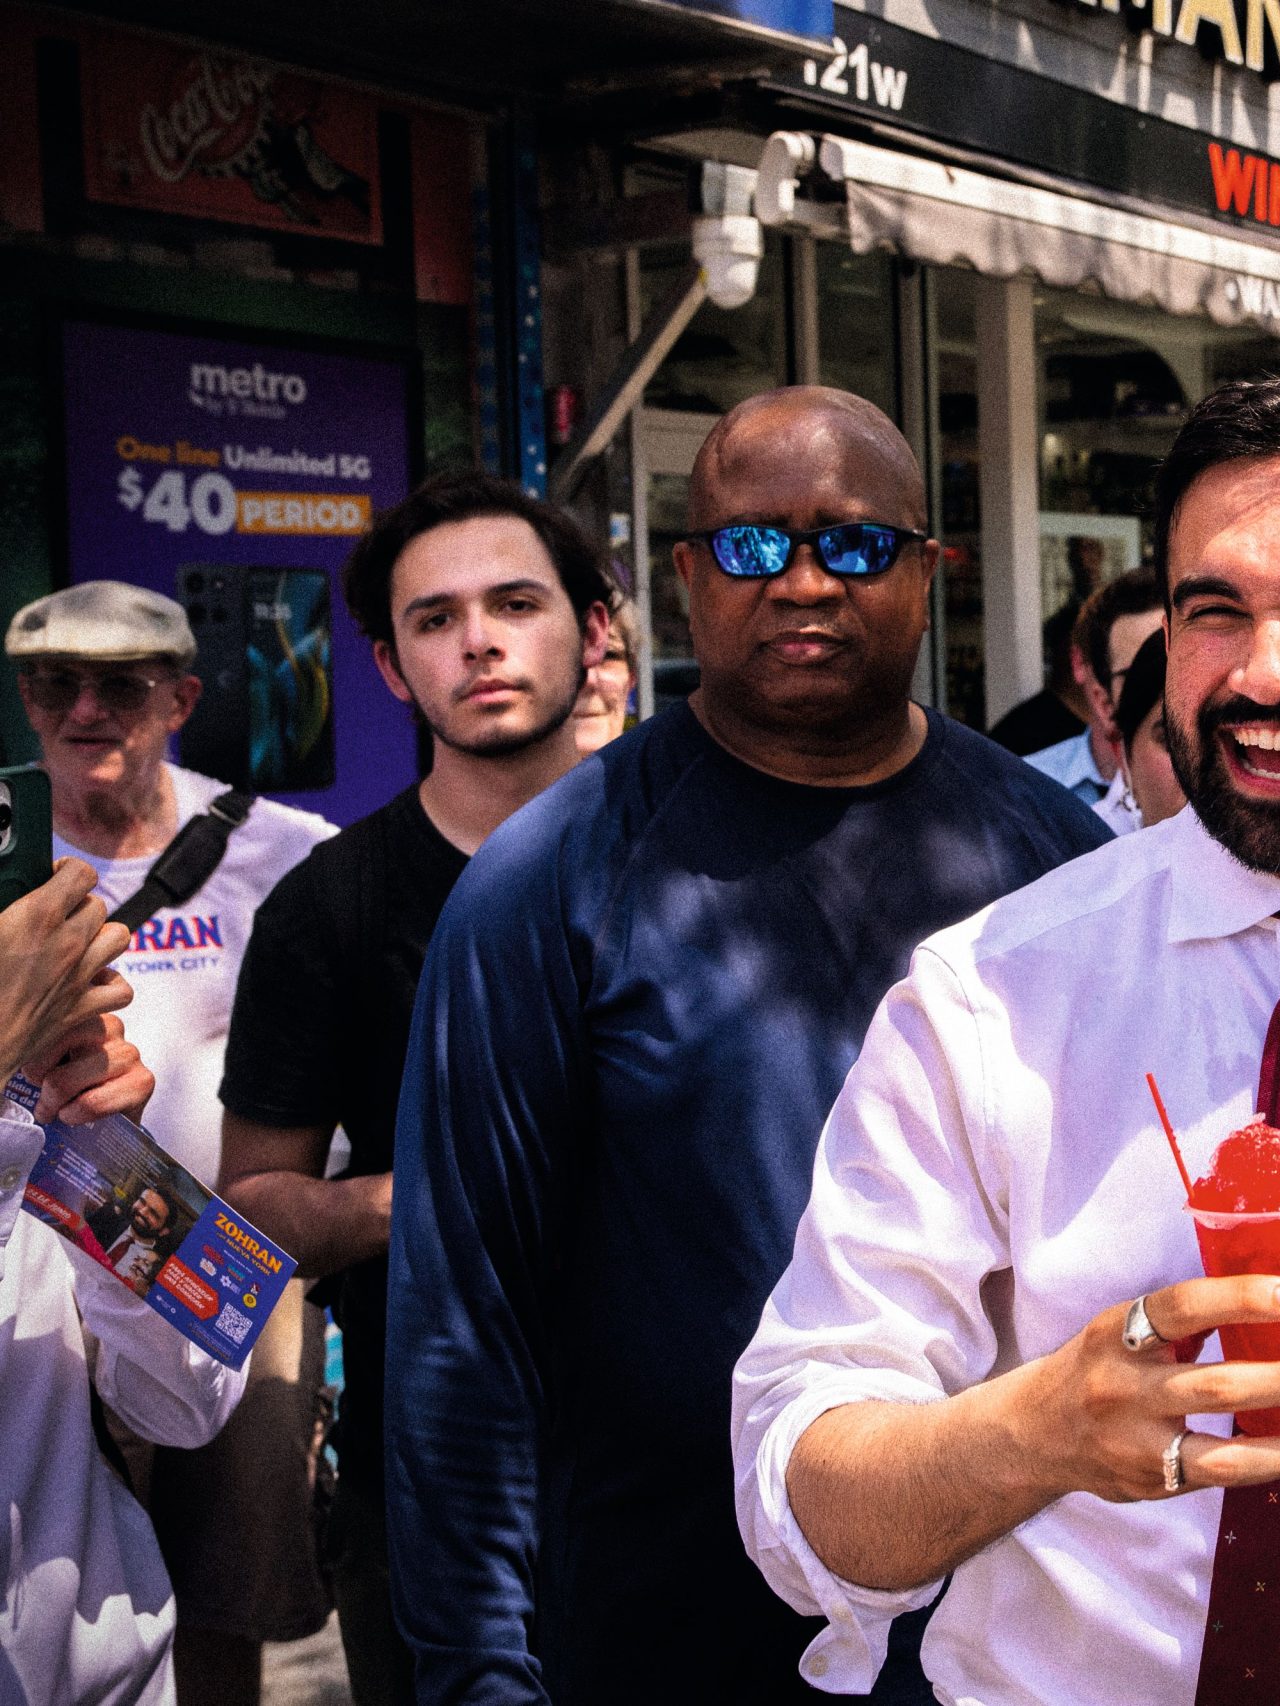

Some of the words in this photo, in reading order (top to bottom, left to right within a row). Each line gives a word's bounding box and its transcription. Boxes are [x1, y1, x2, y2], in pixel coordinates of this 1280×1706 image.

[191, 362, 307, 405] metro
[116, 434, 171, 464] One
[174, 439, 221, 468] line
[223, 444, 336, 478] Unlimited
[338, 454, 373, 481] 5G
[116, 465, 236, 536] $40
[126, 913, 223, 952] RAN
[126, 960, 175, 972] YORK
[180, 955, 220, 970] CITY
[214, 1211, 284, 1275] ZOHRAN
